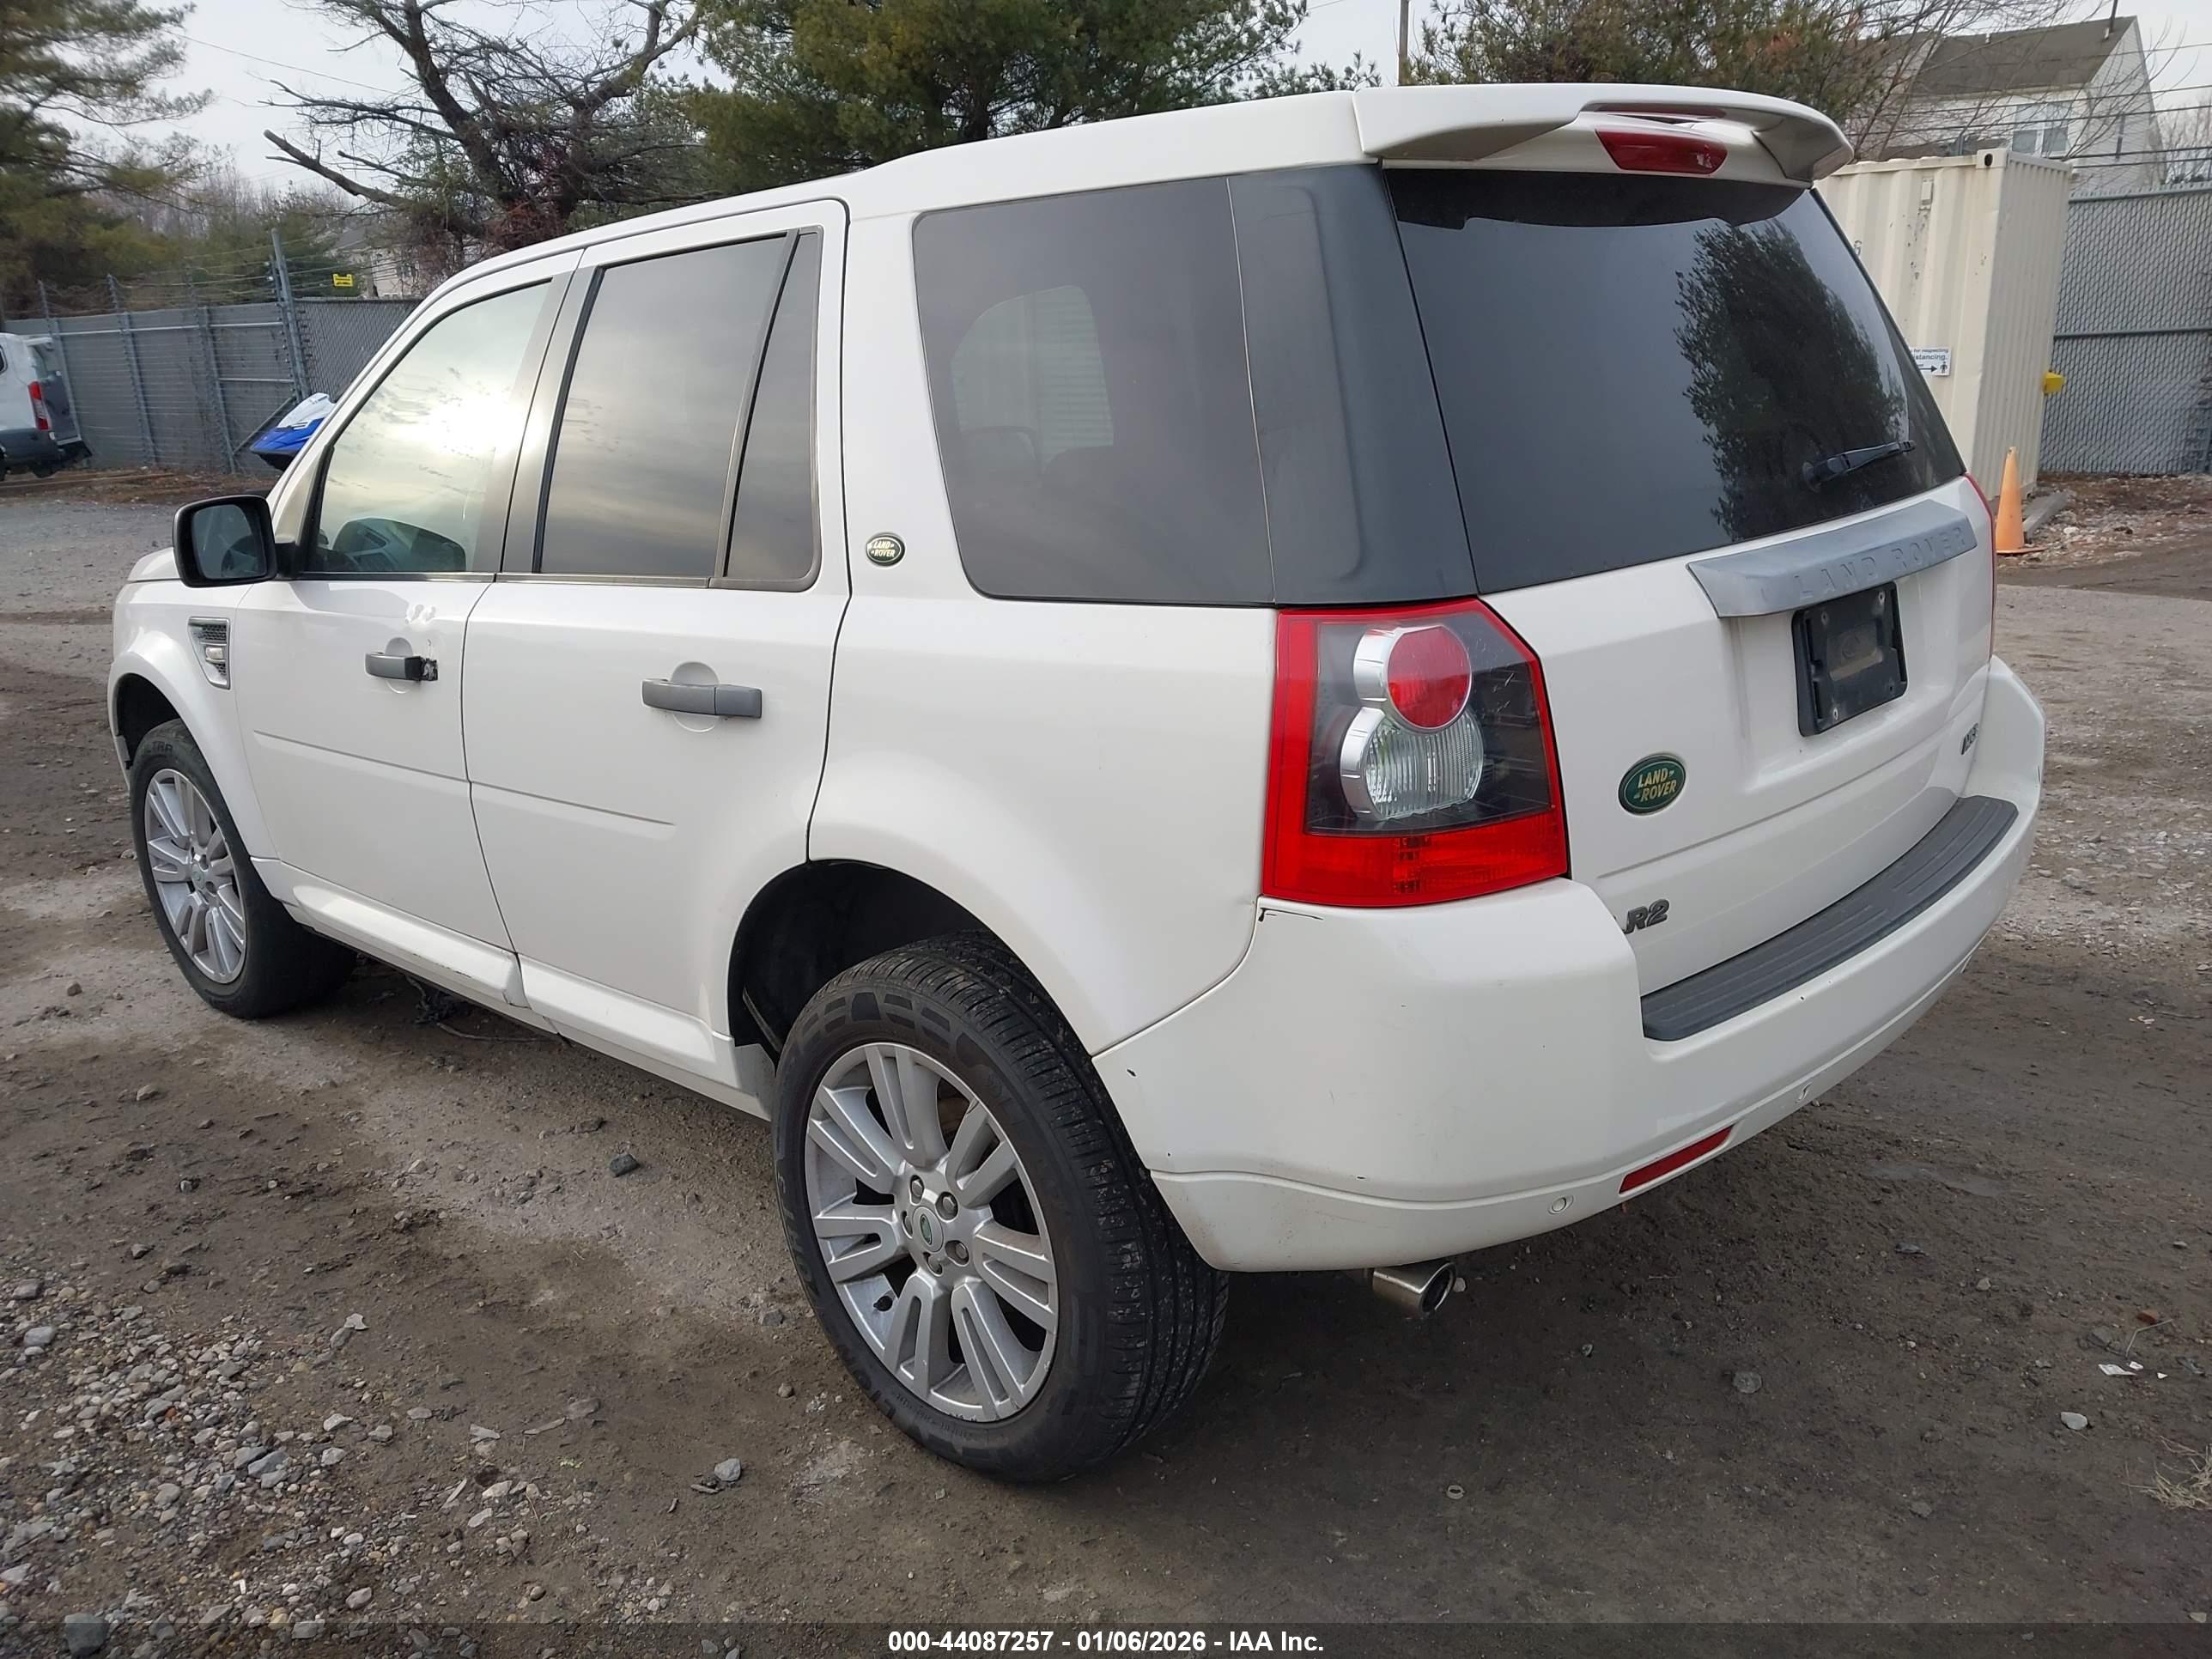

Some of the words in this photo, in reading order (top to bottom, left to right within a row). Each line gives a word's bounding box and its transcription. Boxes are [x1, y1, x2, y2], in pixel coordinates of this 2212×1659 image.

[873, 541, 891, 550] LAND
[1793, 556, 1878, 600] LAND
[1891, 526, 1966, 569] ROVER
[1638, 768, 1668, 788] LAND
[1640, 779, 1677, 803] ROVER
[1621, 898, 1670, 935] R2
